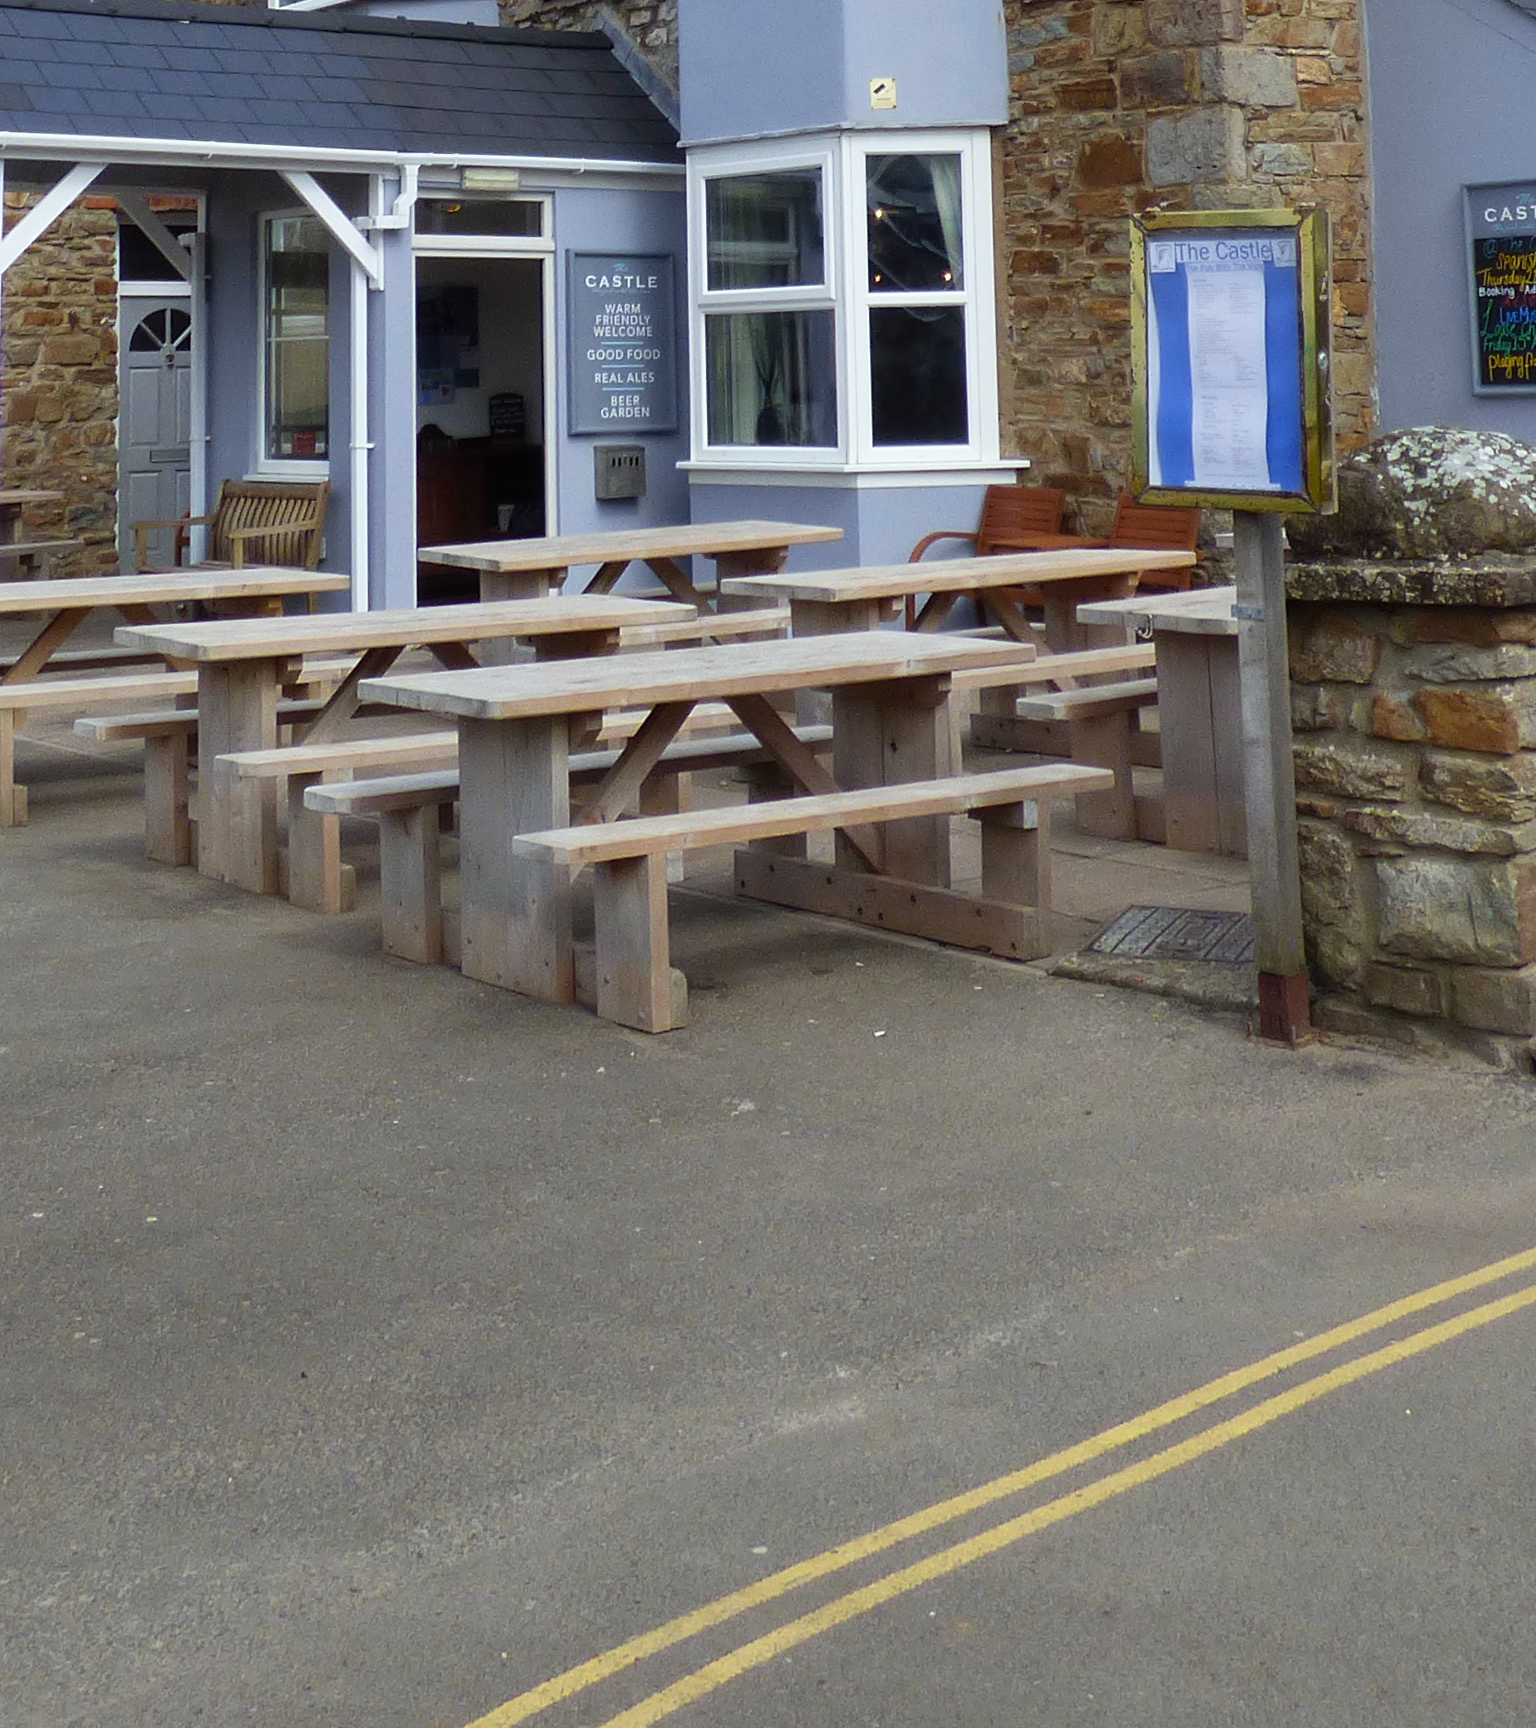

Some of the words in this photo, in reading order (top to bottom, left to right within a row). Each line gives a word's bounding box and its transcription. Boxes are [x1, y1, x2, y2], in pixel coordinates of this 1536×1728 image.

[1175, 242, 1210, 261] The
[1216, 240, 1270, 260] Castle
[585, 275, 658, 288] CASTLE
[1478, 286, 1515, 300] Booking
[604, 303, 641, 314] WARM
[595, 314, 651, 326] FRIENDLY
[593, 326, 653, 337] WELCOME
[587, 349, 624, 360] GOOD
[627, 349, 661, 360] FOOD
[594, 372, 624, 383] REAL
[626, 371, 655, 383] ALES
[610, 395, 640, 406] BEER
[600, 407, 650, 418] GARDEN
